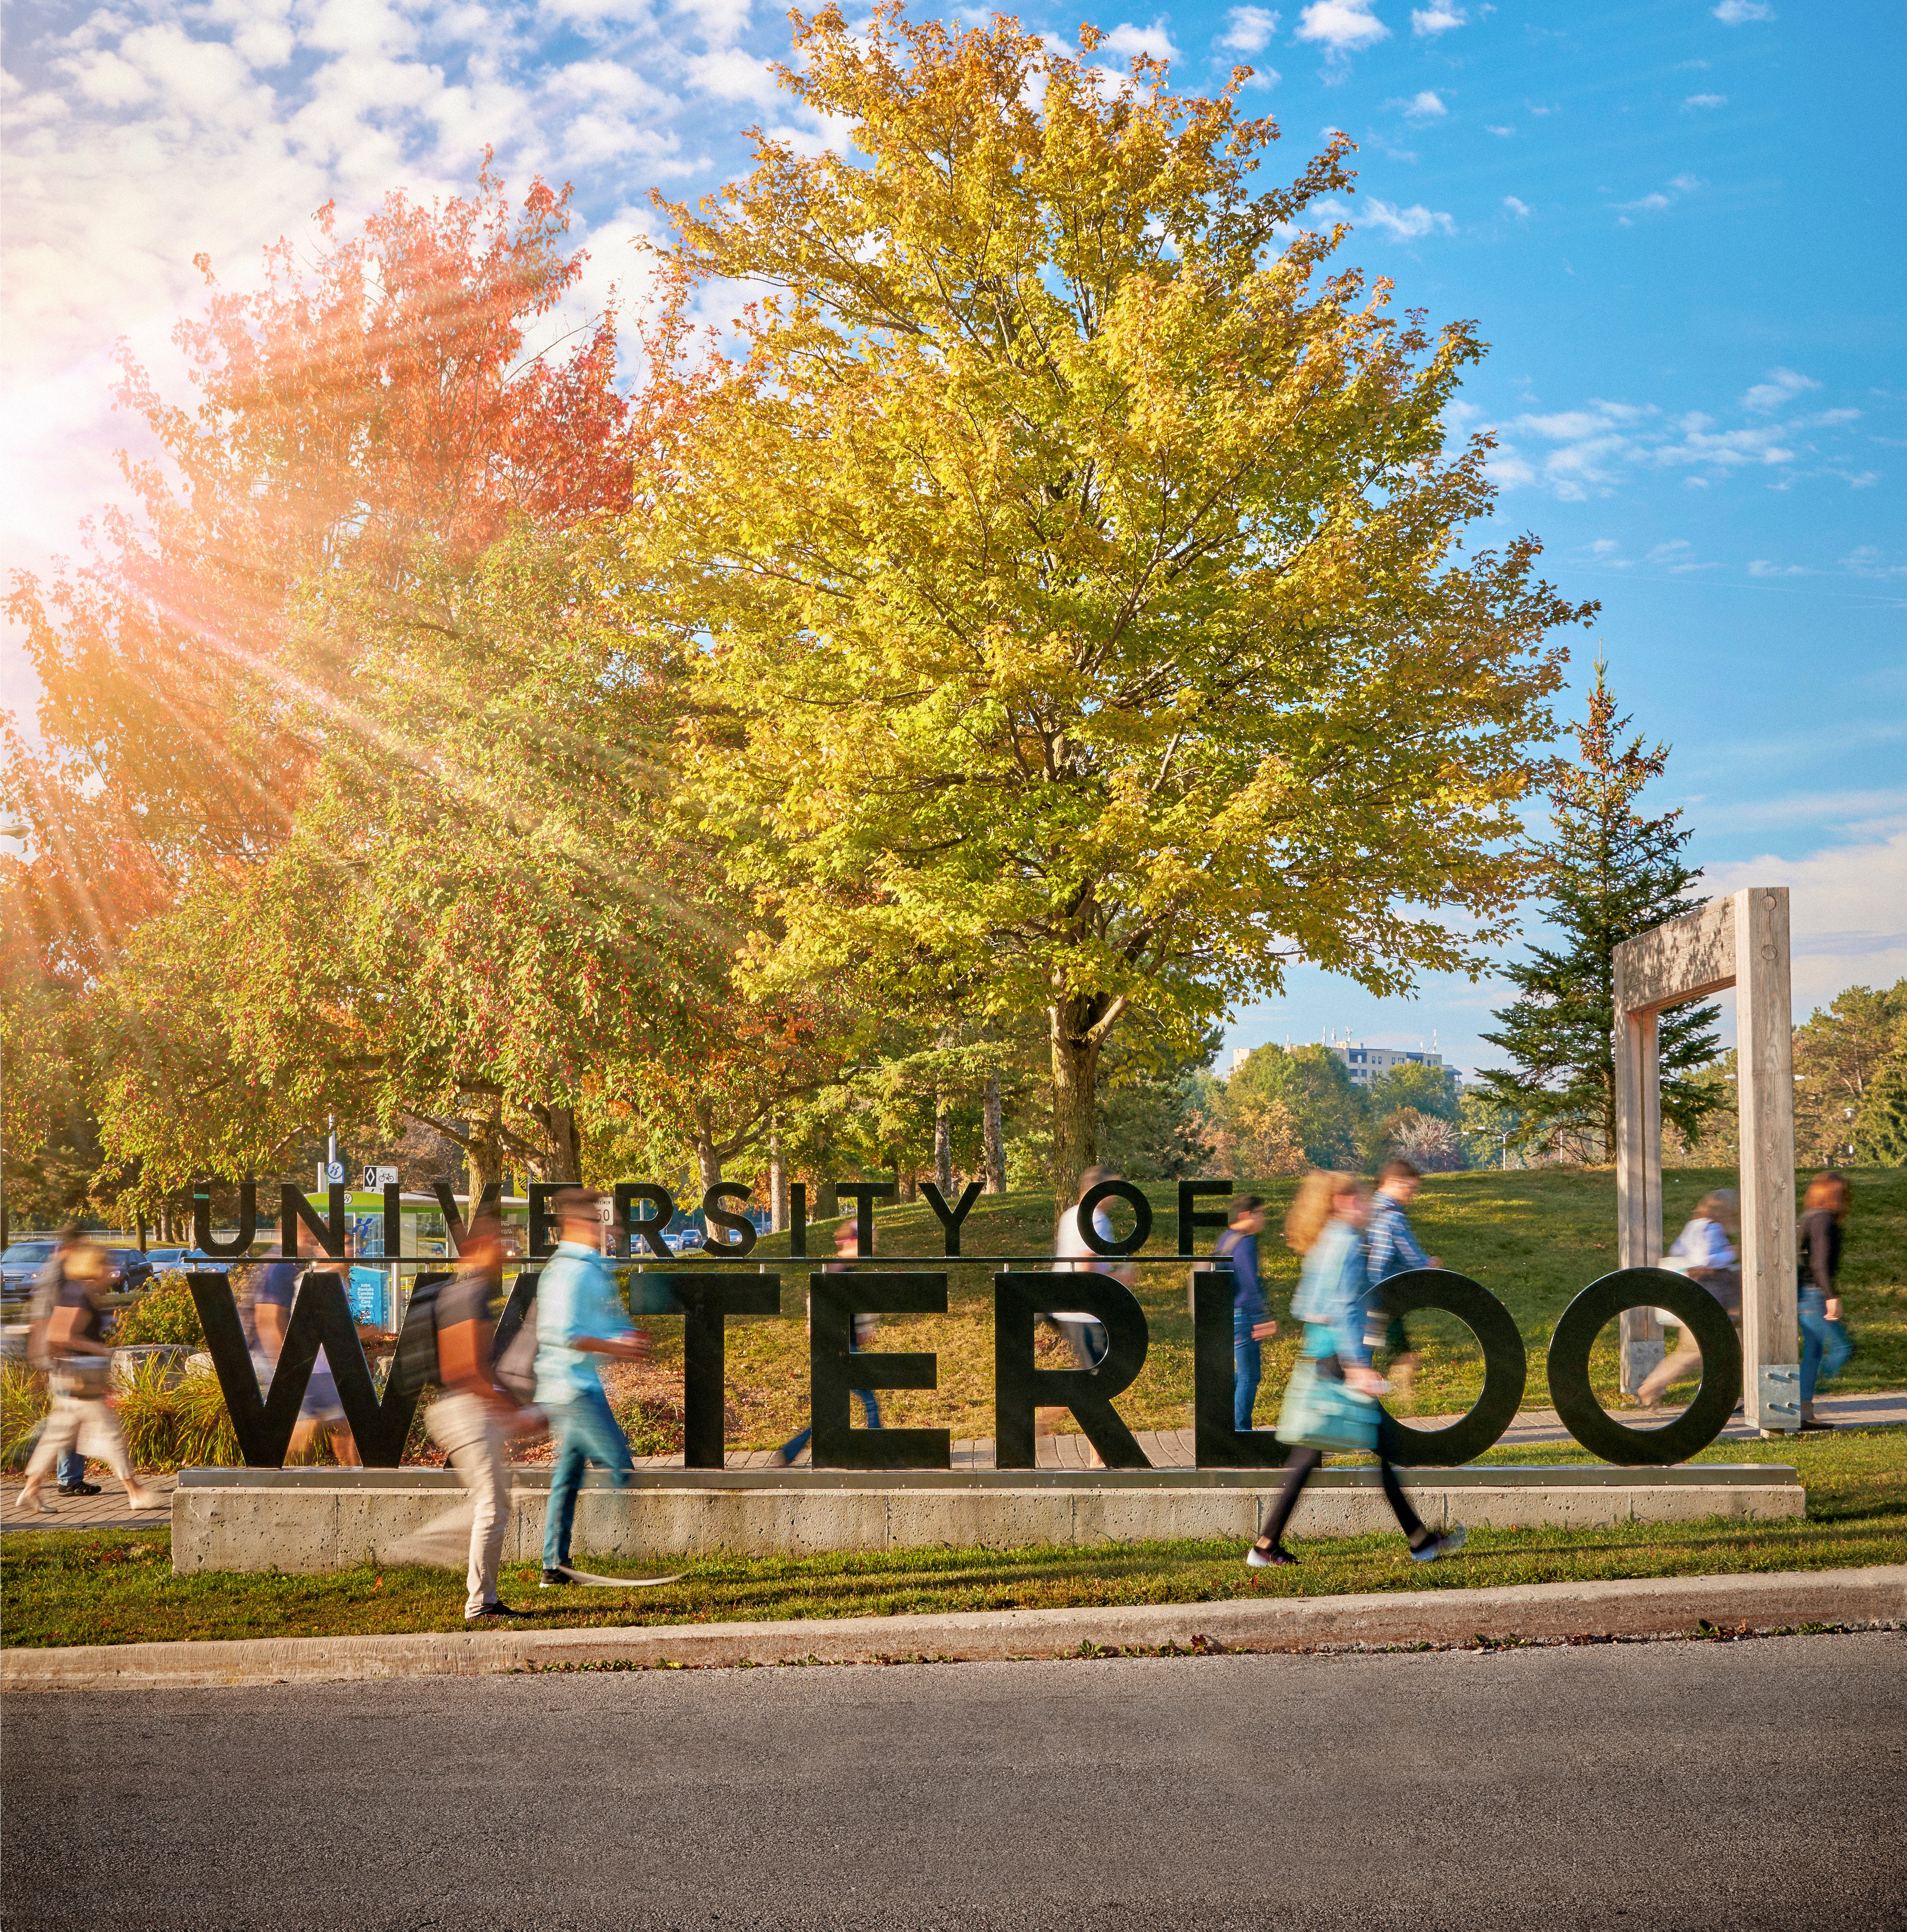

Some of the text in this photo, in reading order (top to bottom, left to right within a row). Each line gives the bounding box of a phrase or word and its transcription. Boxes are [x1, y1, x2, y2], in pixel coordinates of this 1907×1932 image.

[194, 1180, 1233, 1258] UNIVERSITY OF
[596, 1209, 610, 1221] 50
